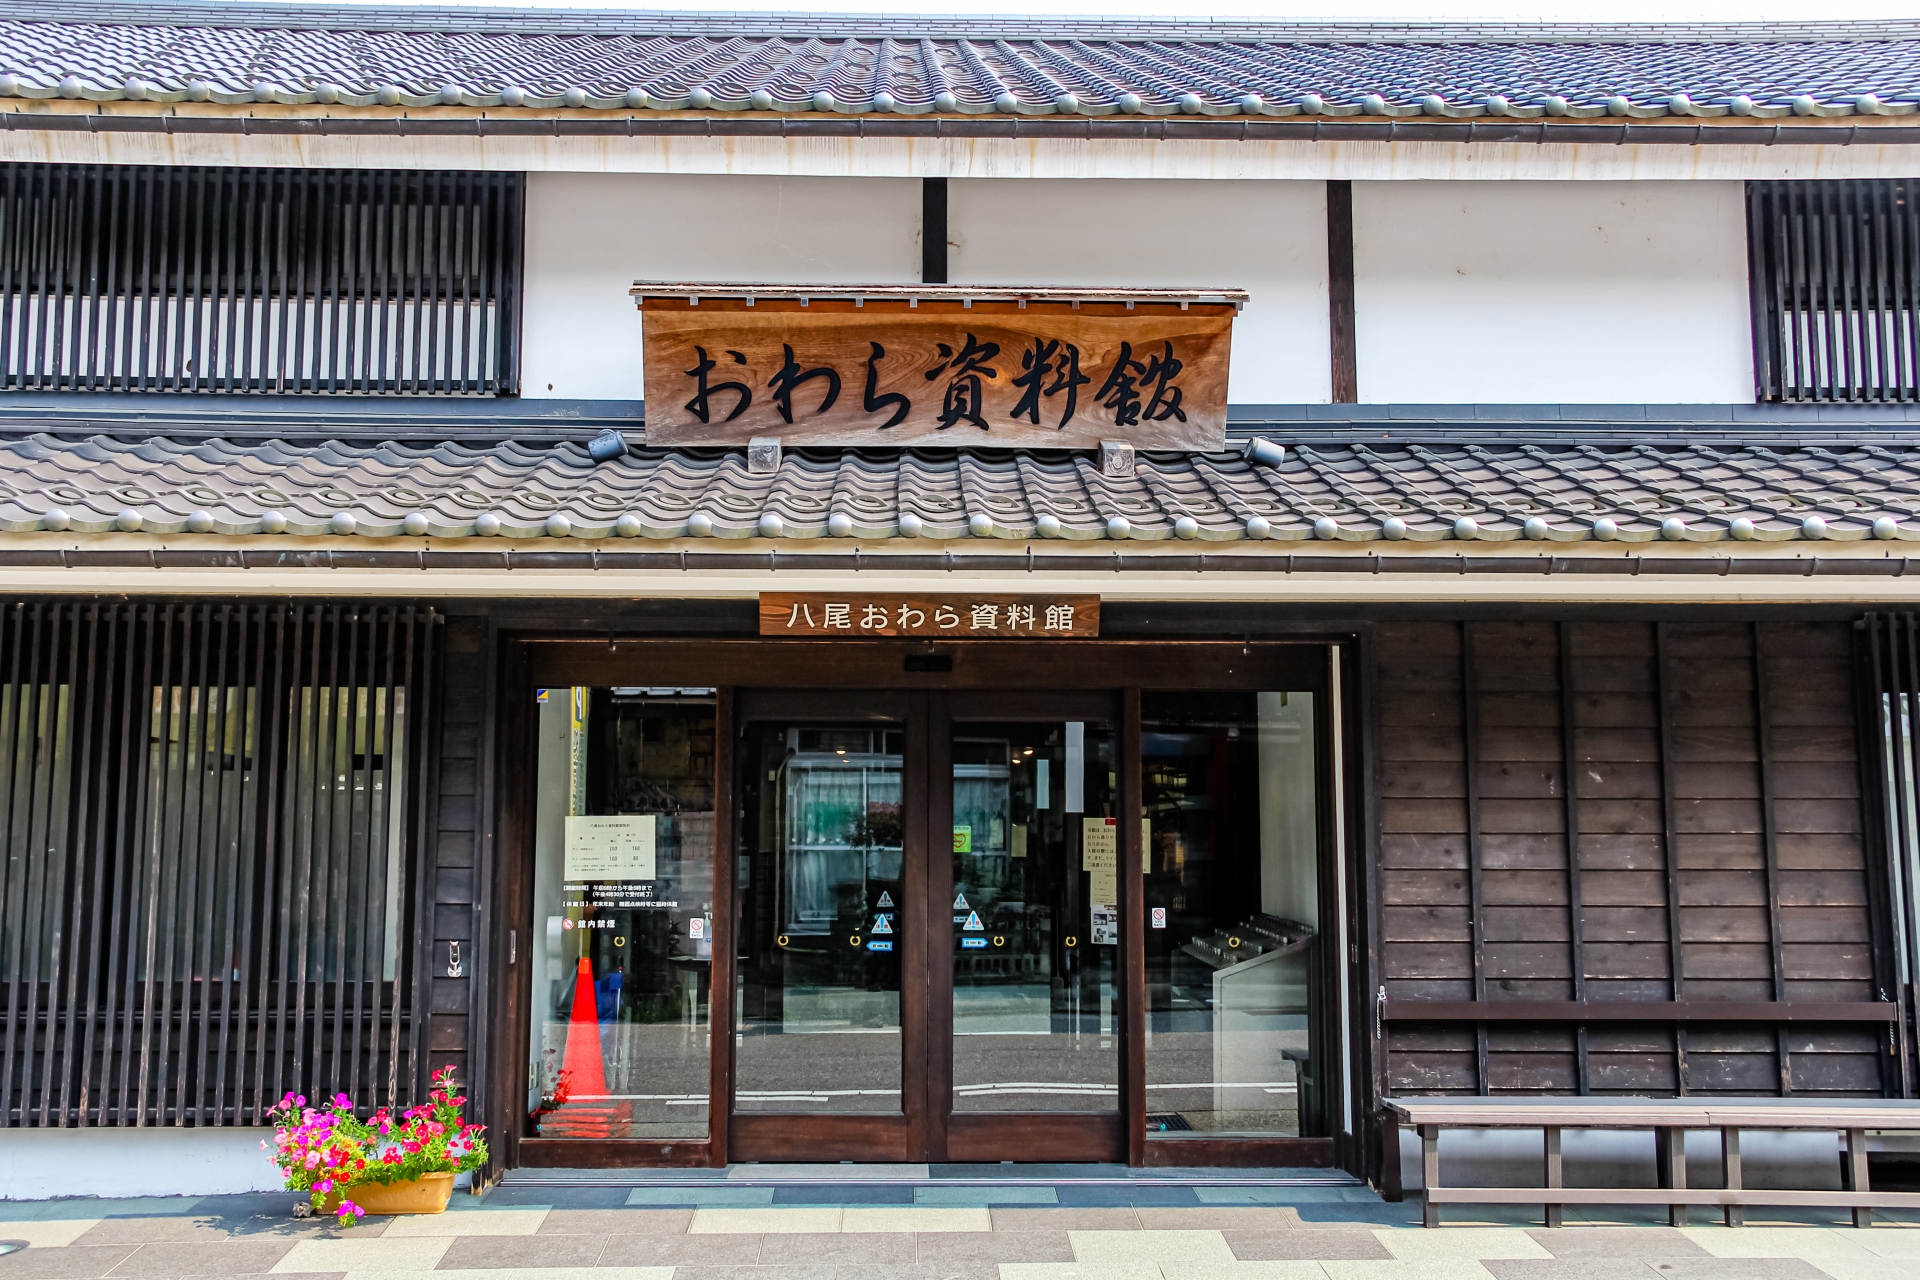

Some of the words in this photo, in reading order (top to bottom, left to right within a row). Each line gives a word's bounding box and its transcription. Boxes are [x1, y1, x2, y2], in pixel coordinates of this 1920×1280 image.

[786, 602, 1076, 631] 八尾おわら資料館
[577, 919, 616, 929] 館内禁煙
